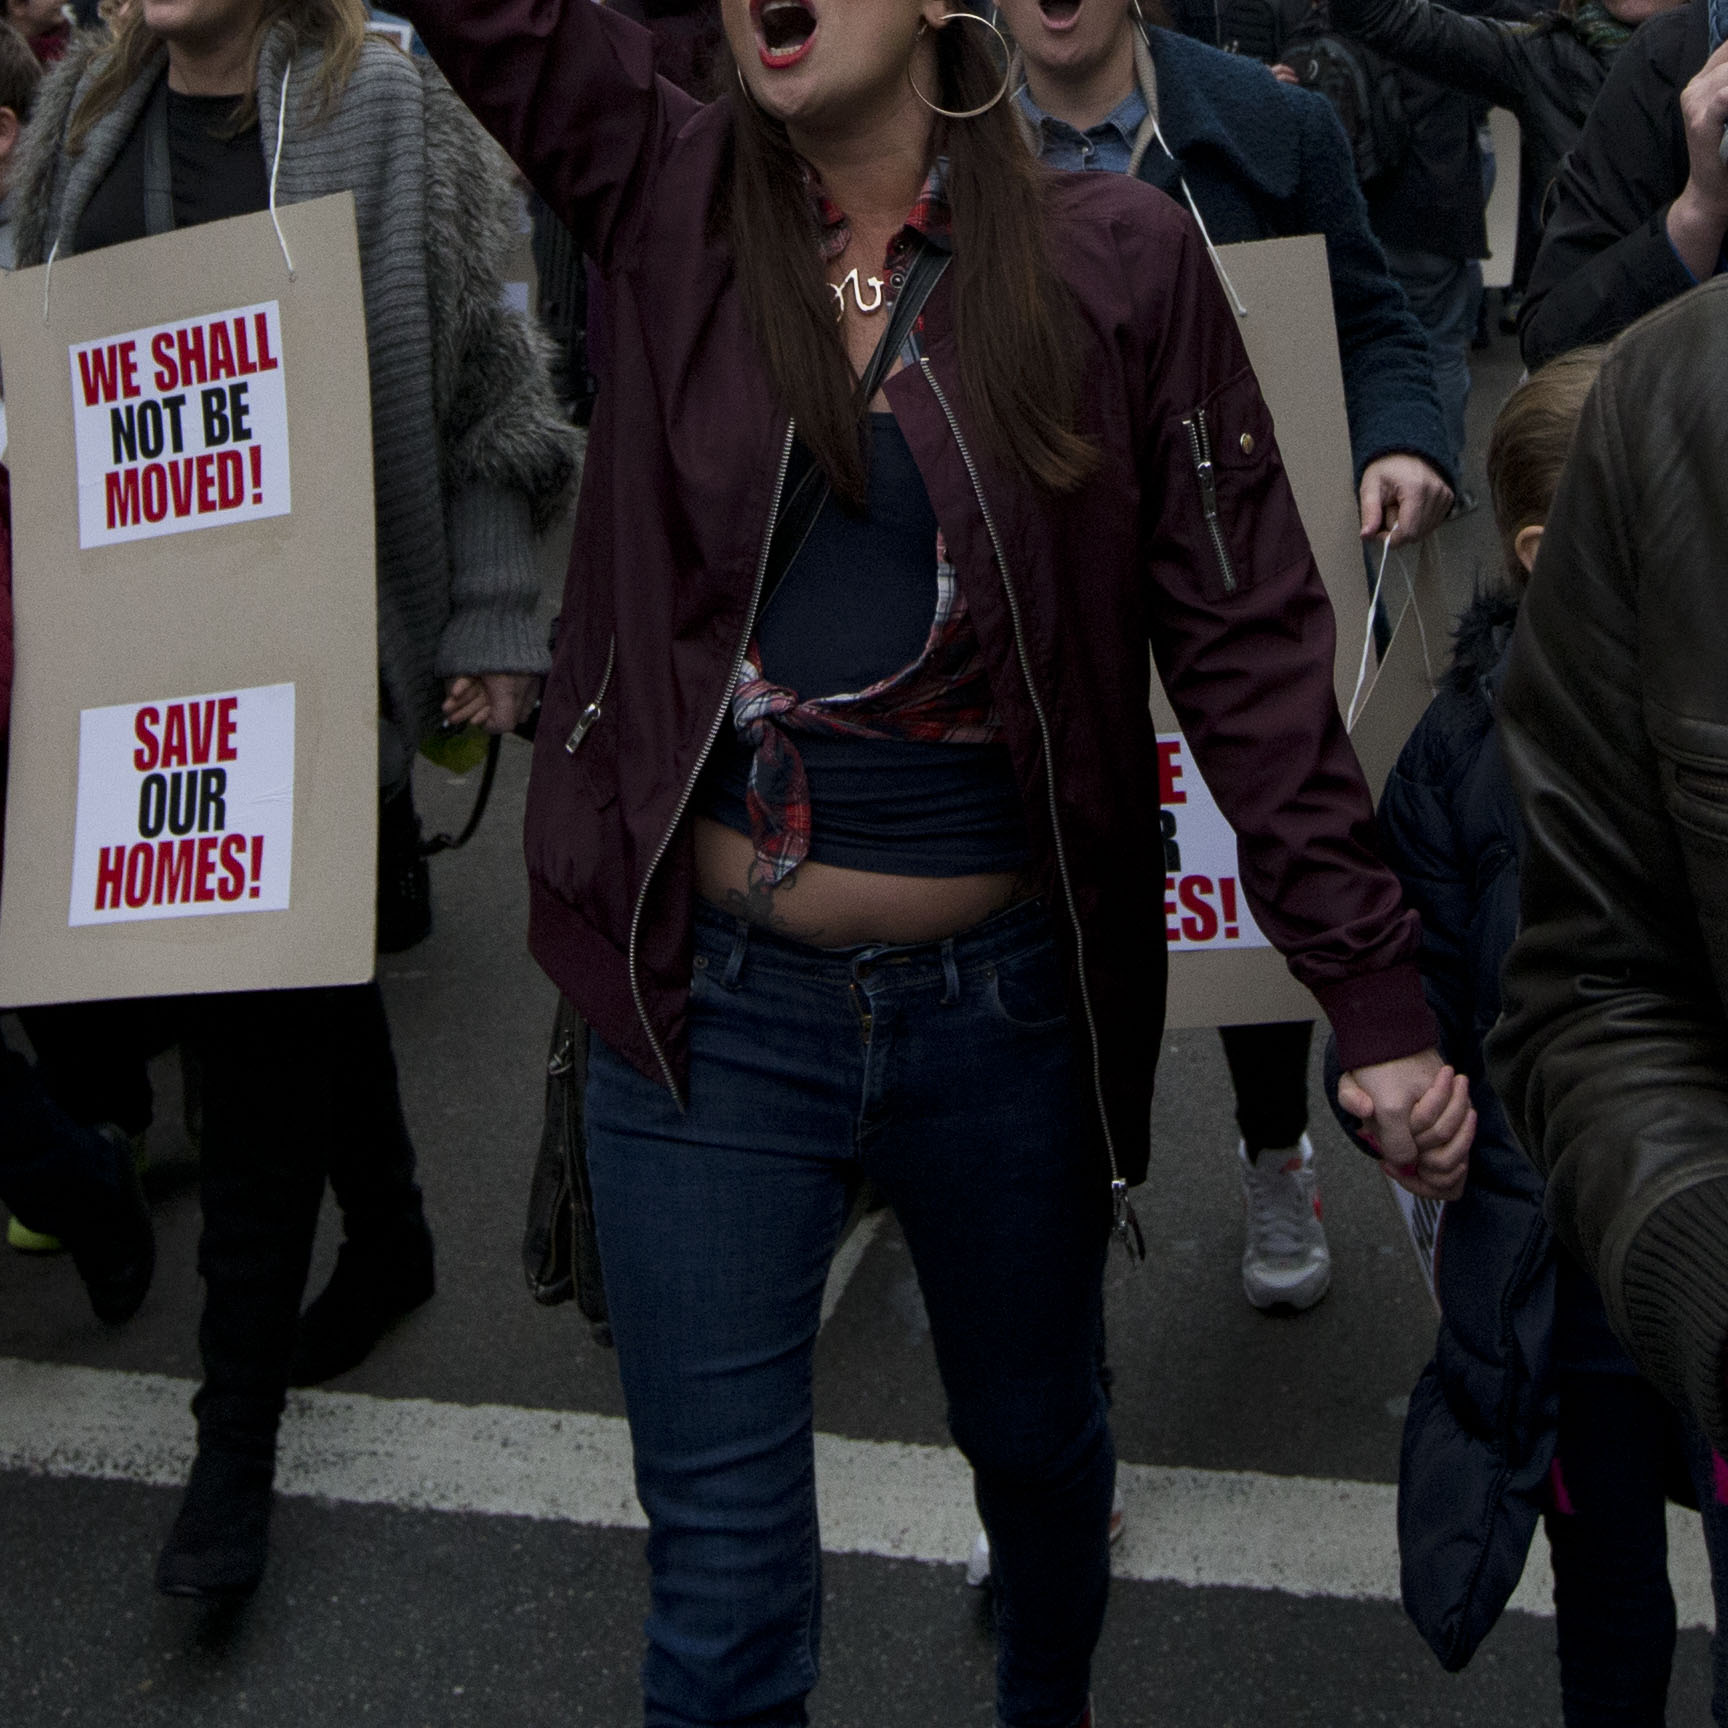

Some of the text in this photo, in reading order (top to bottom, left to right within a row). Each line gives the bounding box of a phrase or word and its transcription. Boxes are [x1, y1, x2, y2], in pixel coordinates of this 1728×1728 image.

[78, 312, 278, 407] WE SHALL
[110, 381, 252, 465] NOT BE
[105, 444, 263, 530] MOVED!
[133, 696, 238, 772] SAVE
[138, 768, 227, 839] OUR
[94, 833, 265, 910] HOMES!
